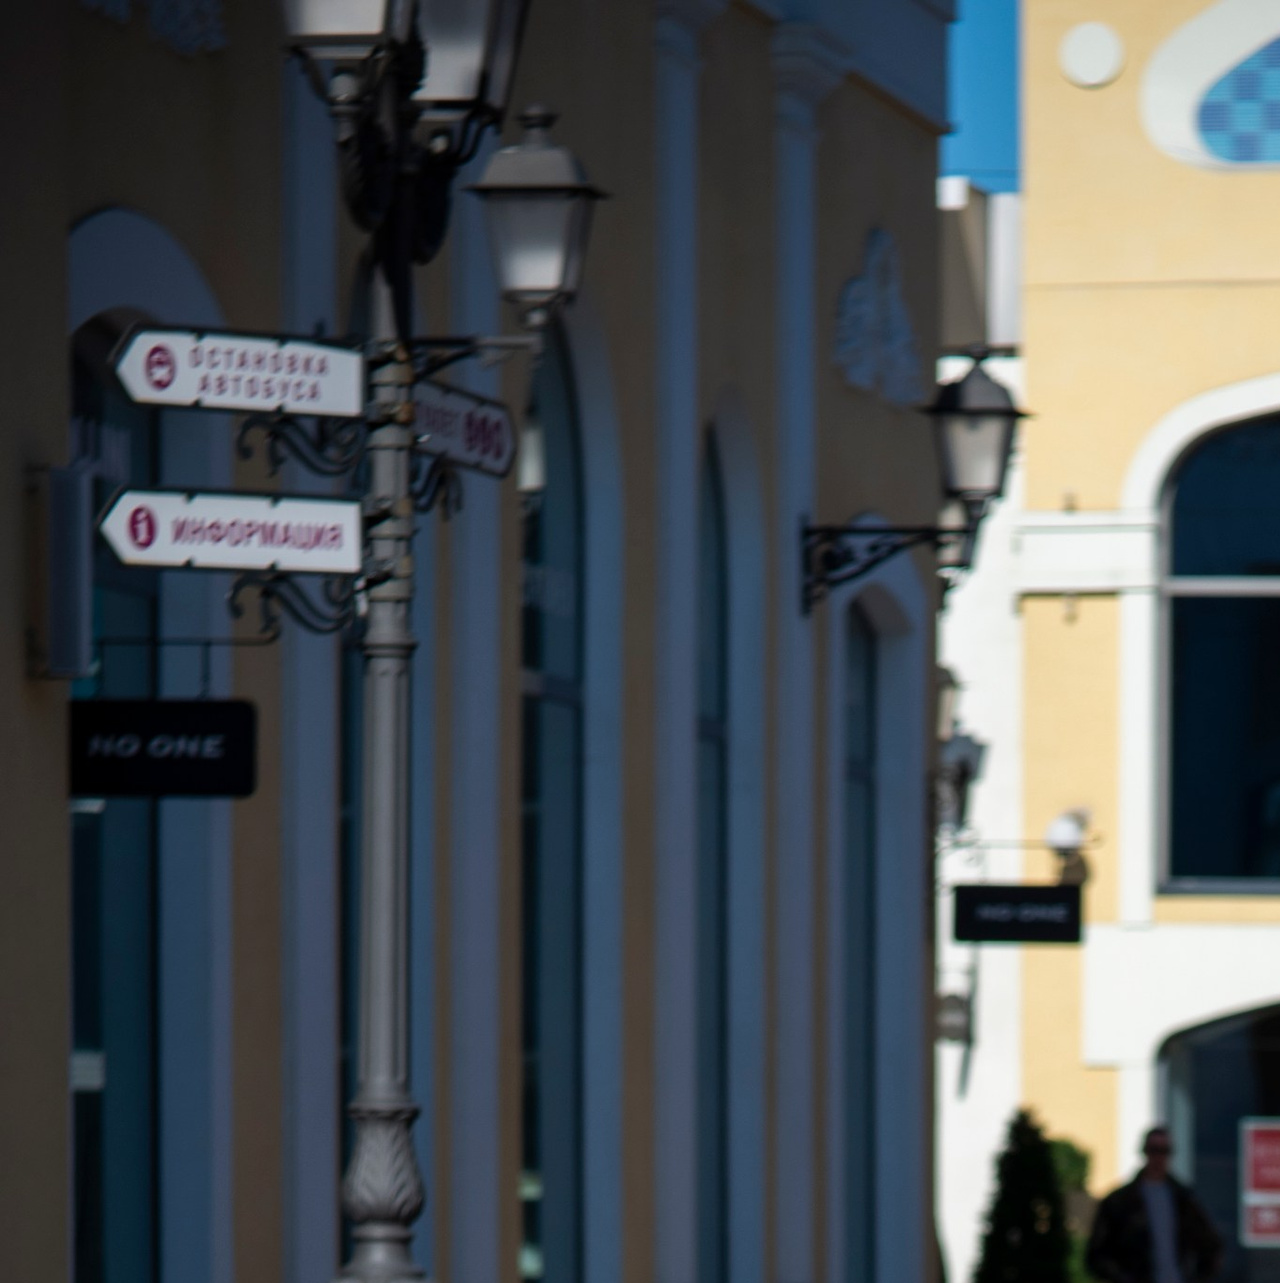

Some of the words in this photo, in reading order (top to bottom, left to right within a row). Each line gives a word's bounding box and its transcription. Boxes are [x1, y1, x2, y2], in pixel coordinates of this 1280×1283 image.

[188, 346, 329, 376] ОСТАНОВКА
[199, 373, 321, 402] АВТОБУСА
[172, 516, 343, 550] ИНФОРМАЦИЯ
[87, 734, 142, 759] NO
[146, 734, 226, 760] ONE
